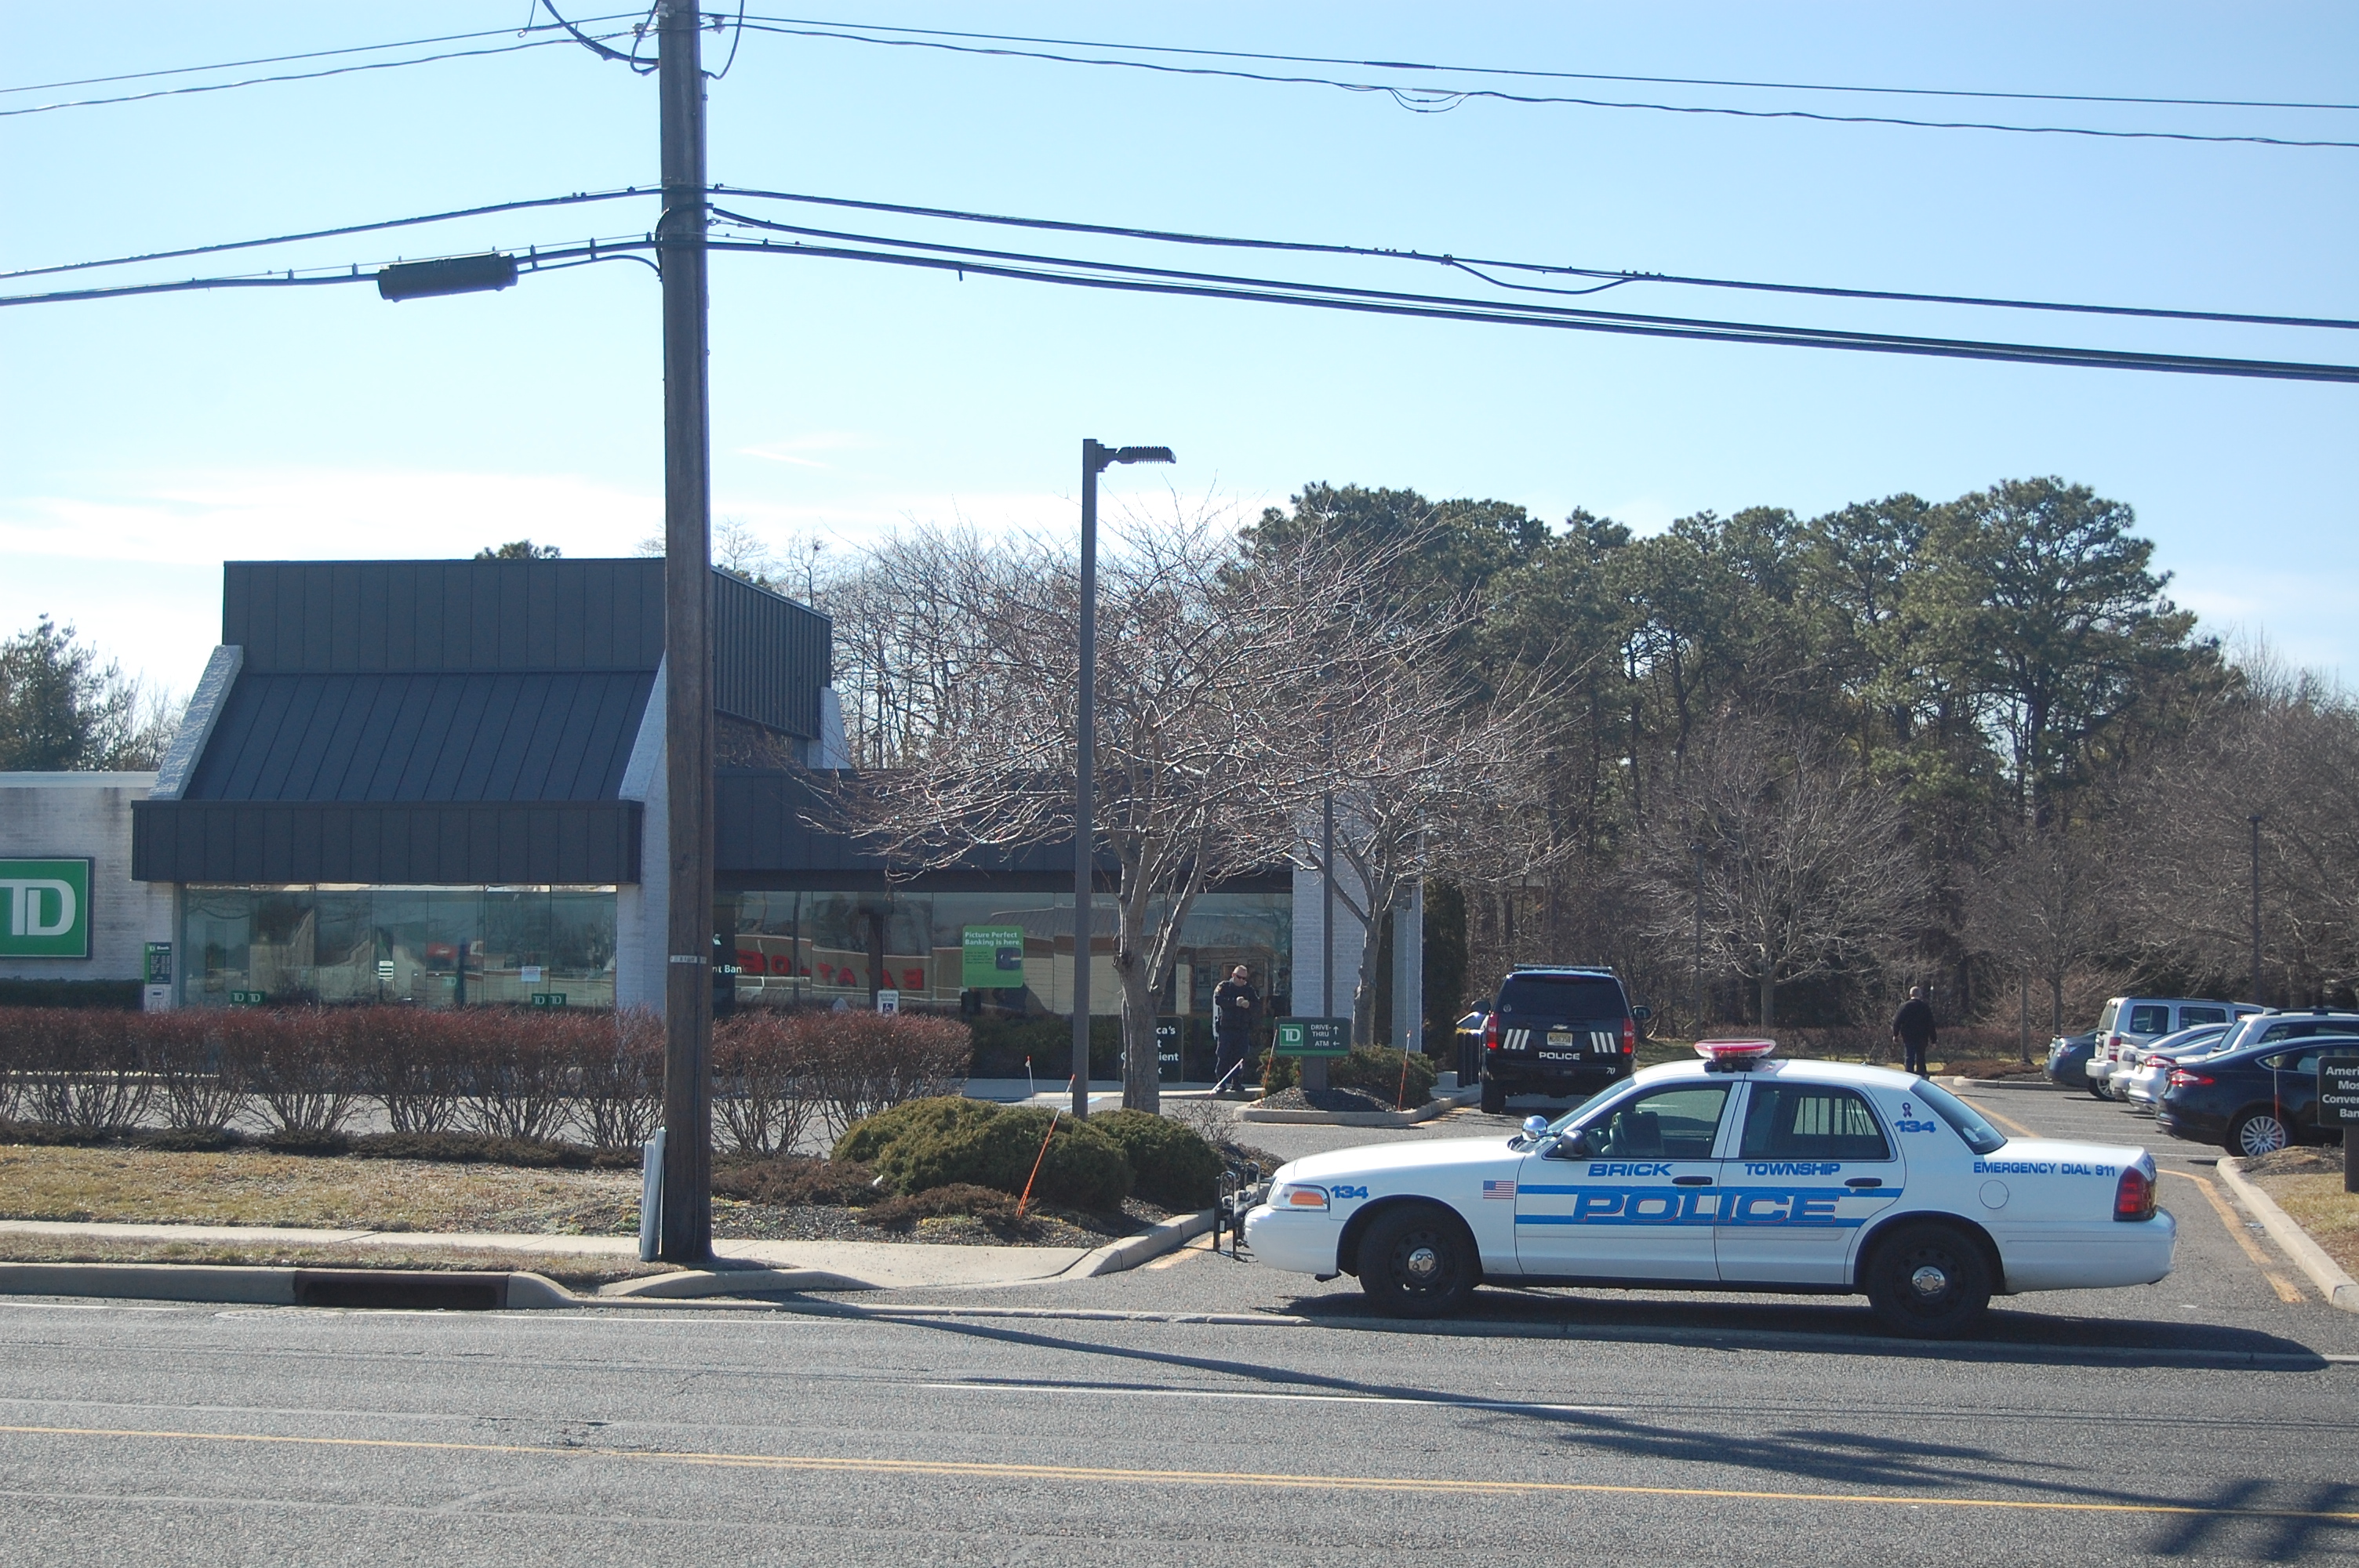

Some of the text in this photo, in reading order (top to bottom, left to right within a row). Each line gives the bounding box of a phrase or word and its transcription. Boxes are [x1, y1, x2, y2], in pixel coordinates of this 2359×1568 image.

[0, 879, 77, 935] TD
[965, 938, 994, 947] Banking
[233, 993, 245, 1002] TD
[249, 993, 260, 1002] TD
[533, 996, 545, 1004] TD
[550, 996, 562, 1004] TD
[1282, 1028, 1302, 1042] TD
[1539, 1051, 1580, 1060] POLICE
[1893, 1120, 1937, 1134] 134
[1587, 1162, 1842, 1178] BRICK TOWNSHIP
[1972, 1161, 2117, 1178] EMERGENCY DIAL 911
[1329, 1185, 1369, 1200] 134
[1573, 1191, 1841, 1224] POLICE
